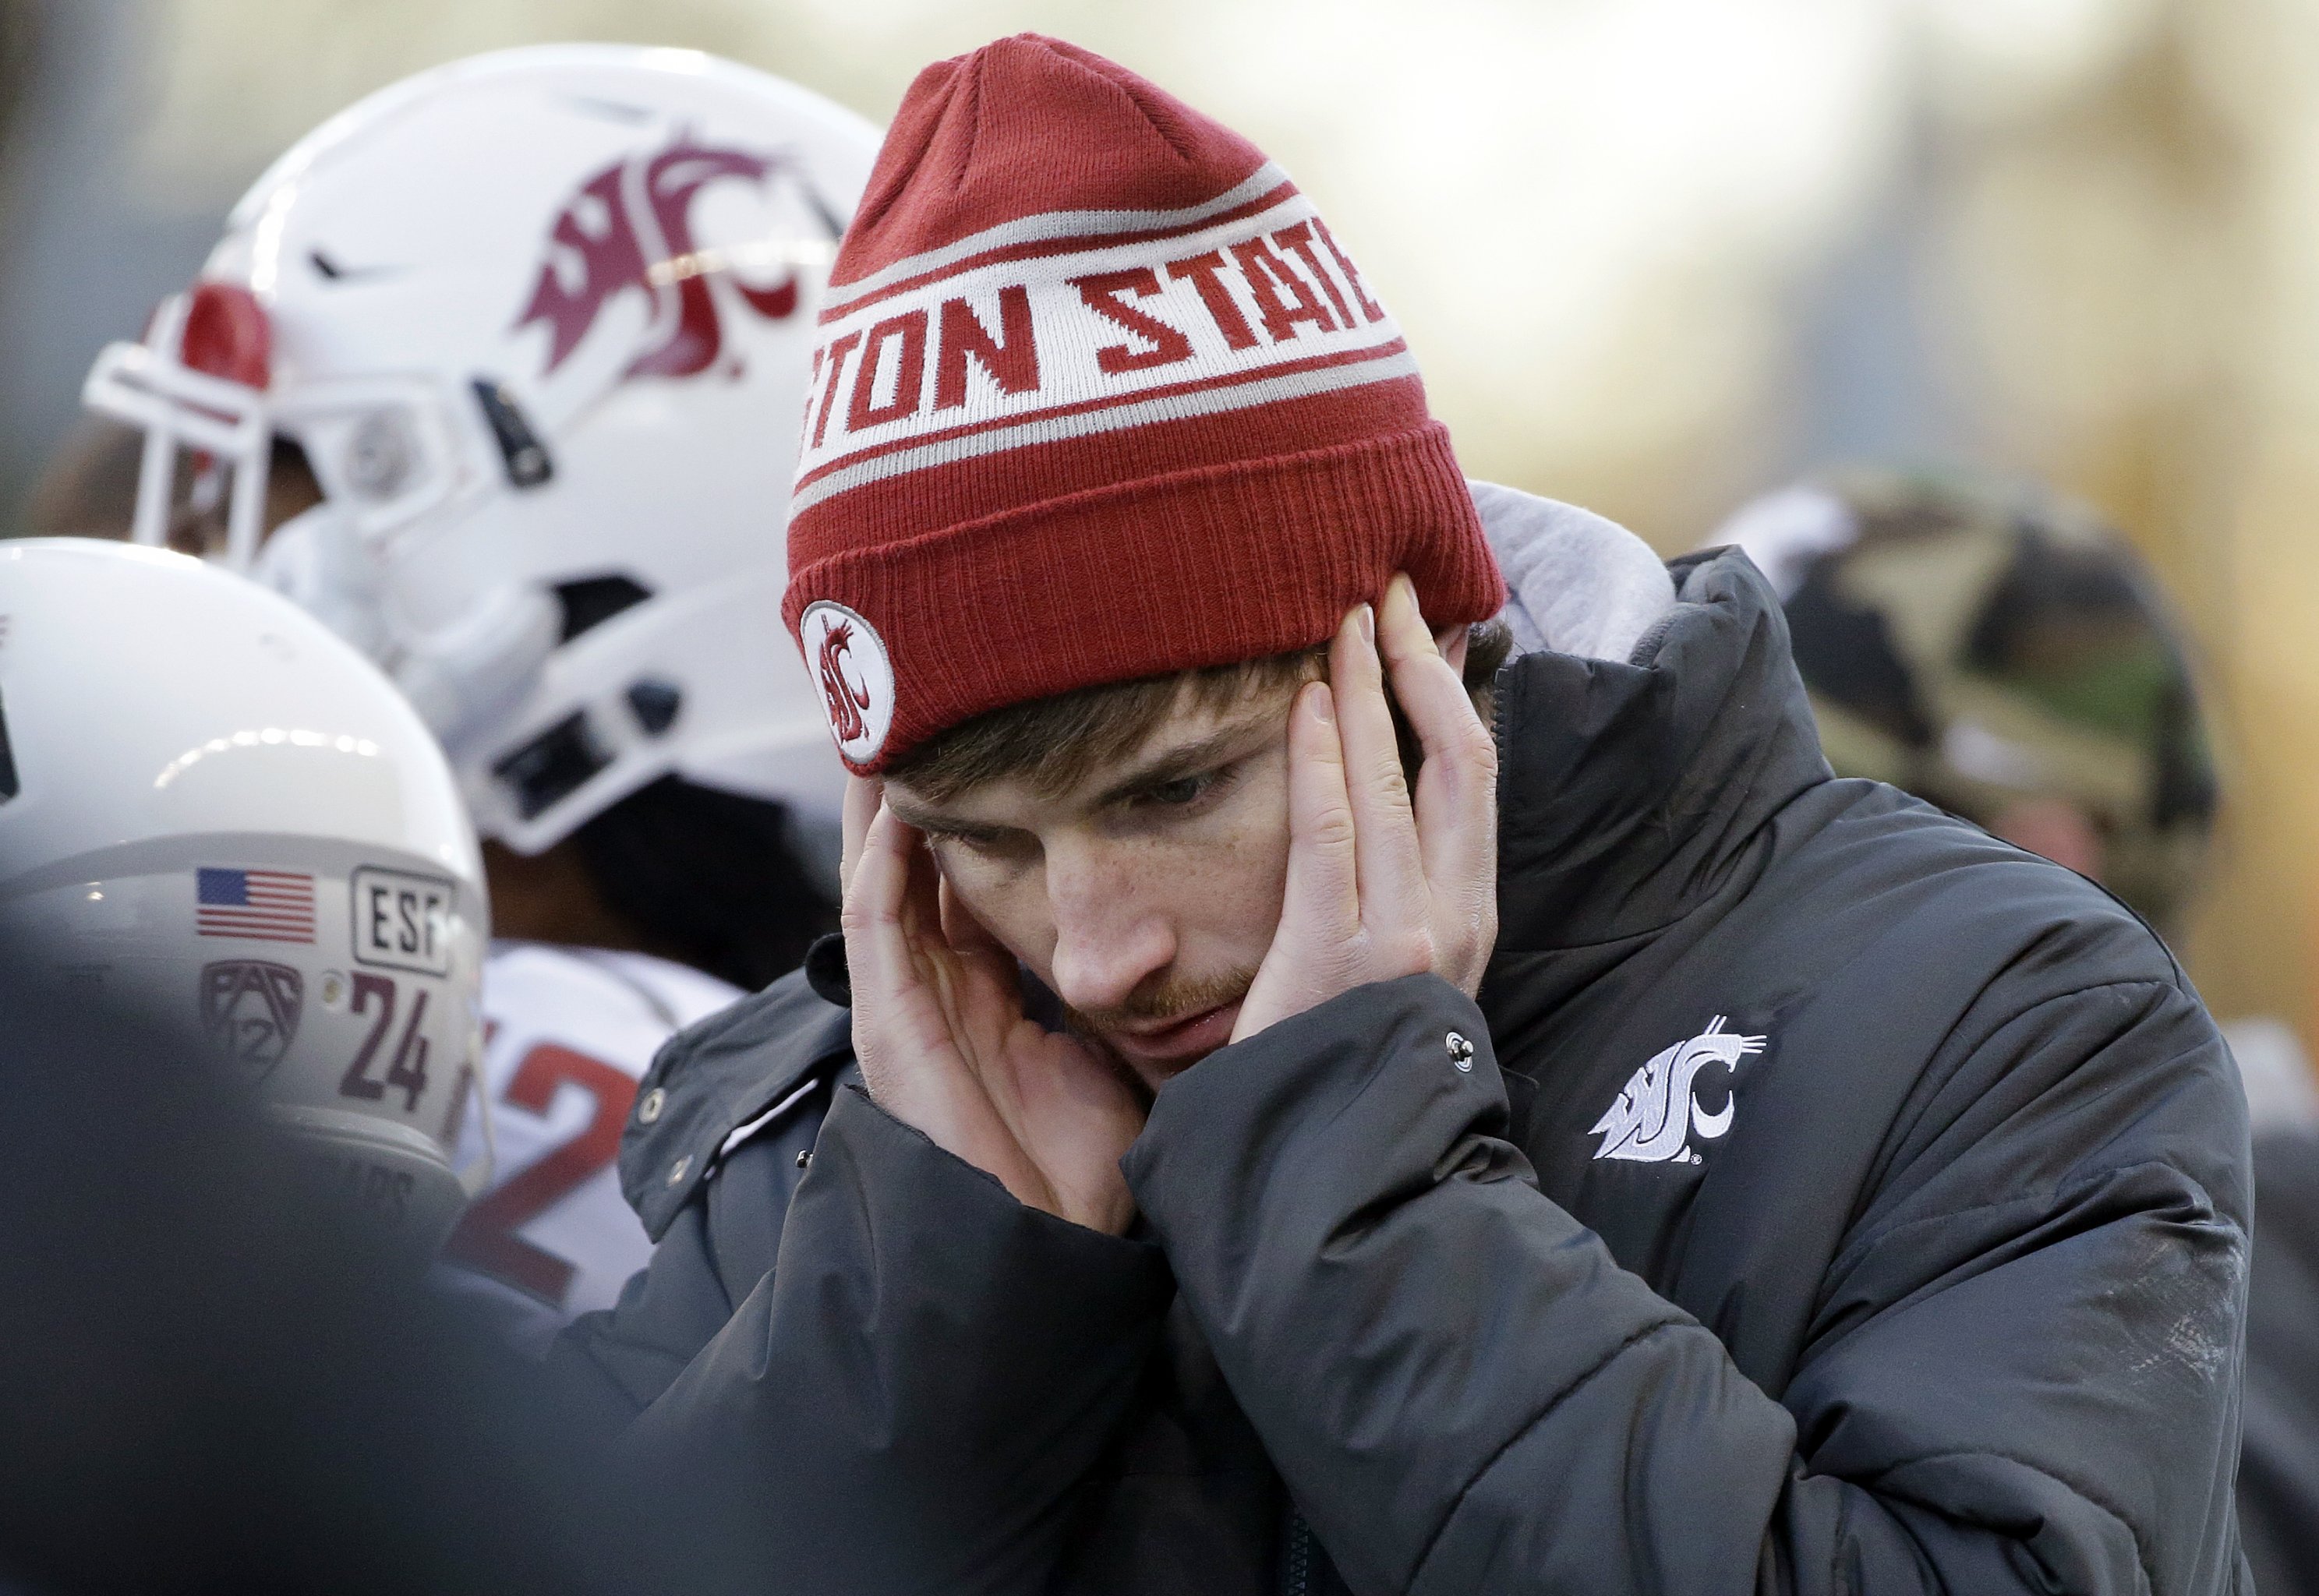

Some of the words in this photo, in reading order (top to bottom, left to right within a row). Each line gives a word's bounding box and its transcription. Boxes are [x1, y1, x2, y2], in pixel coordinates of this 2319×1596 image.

[801, 285, 1040, 450] TON
[204, 963, 302, 1030] PAC
[338, 969, 430, 1113] 24
[440, 1021, 639, 1306] 2
